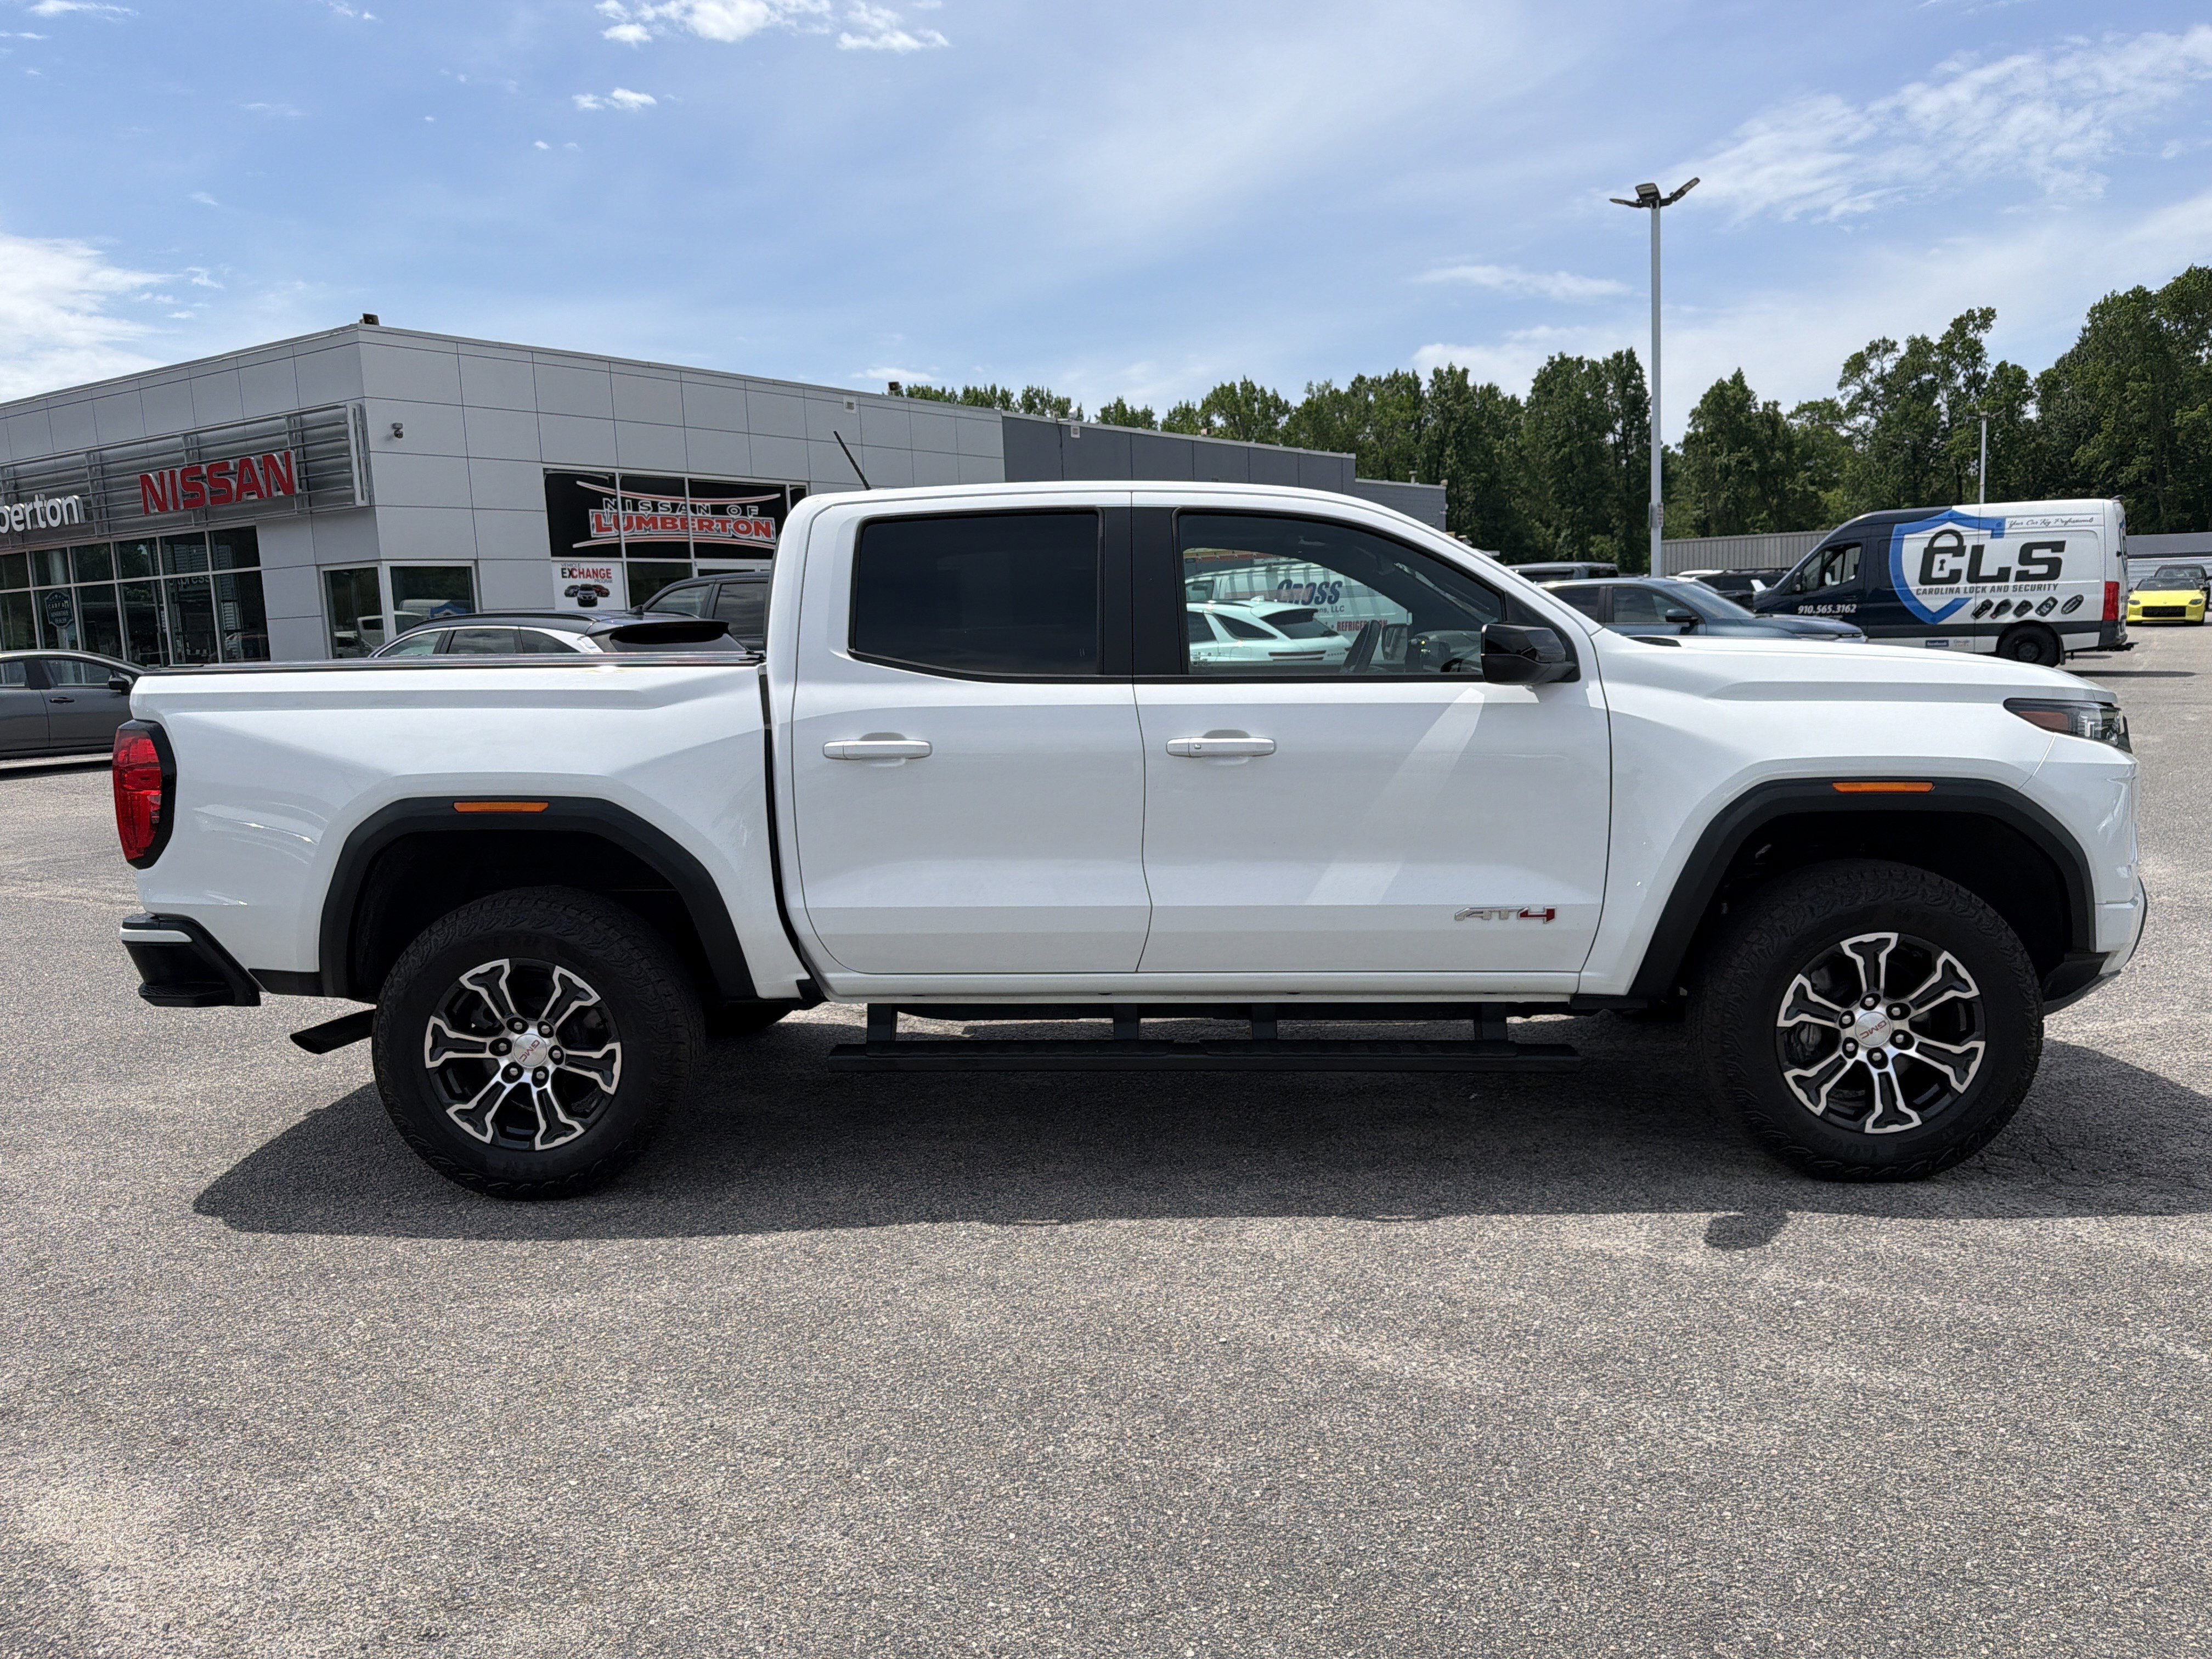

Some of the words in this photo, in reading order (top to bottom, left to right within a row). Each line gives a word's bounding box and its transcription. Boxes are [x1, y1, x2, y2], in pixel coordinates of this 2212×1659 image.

[139, 451, 296, 514] NISSAN
[602, 498, 713, 515] NISSAN
[726, 504, 759, 518] OF
[591, 511, 775, 541] LUMBERTON
[1918, 535, 2067, 585] CLS
[561, 567, 612, 579] EXCHANGE
[1915, 586, 1961, 596] CAROLINA
[1963, 586, 1987, 594] LOCK
[1989, 585, 2010, 593] AND
[2012, 583, 2059, 592] SECURITY
[1798, 603, 1857, 614] 910.565.3162
[1454, 906, 1557, 924] AT4
[1859, 1020, 1887, 1040] GMC
[519, 1039, 540, 1062] GMC
